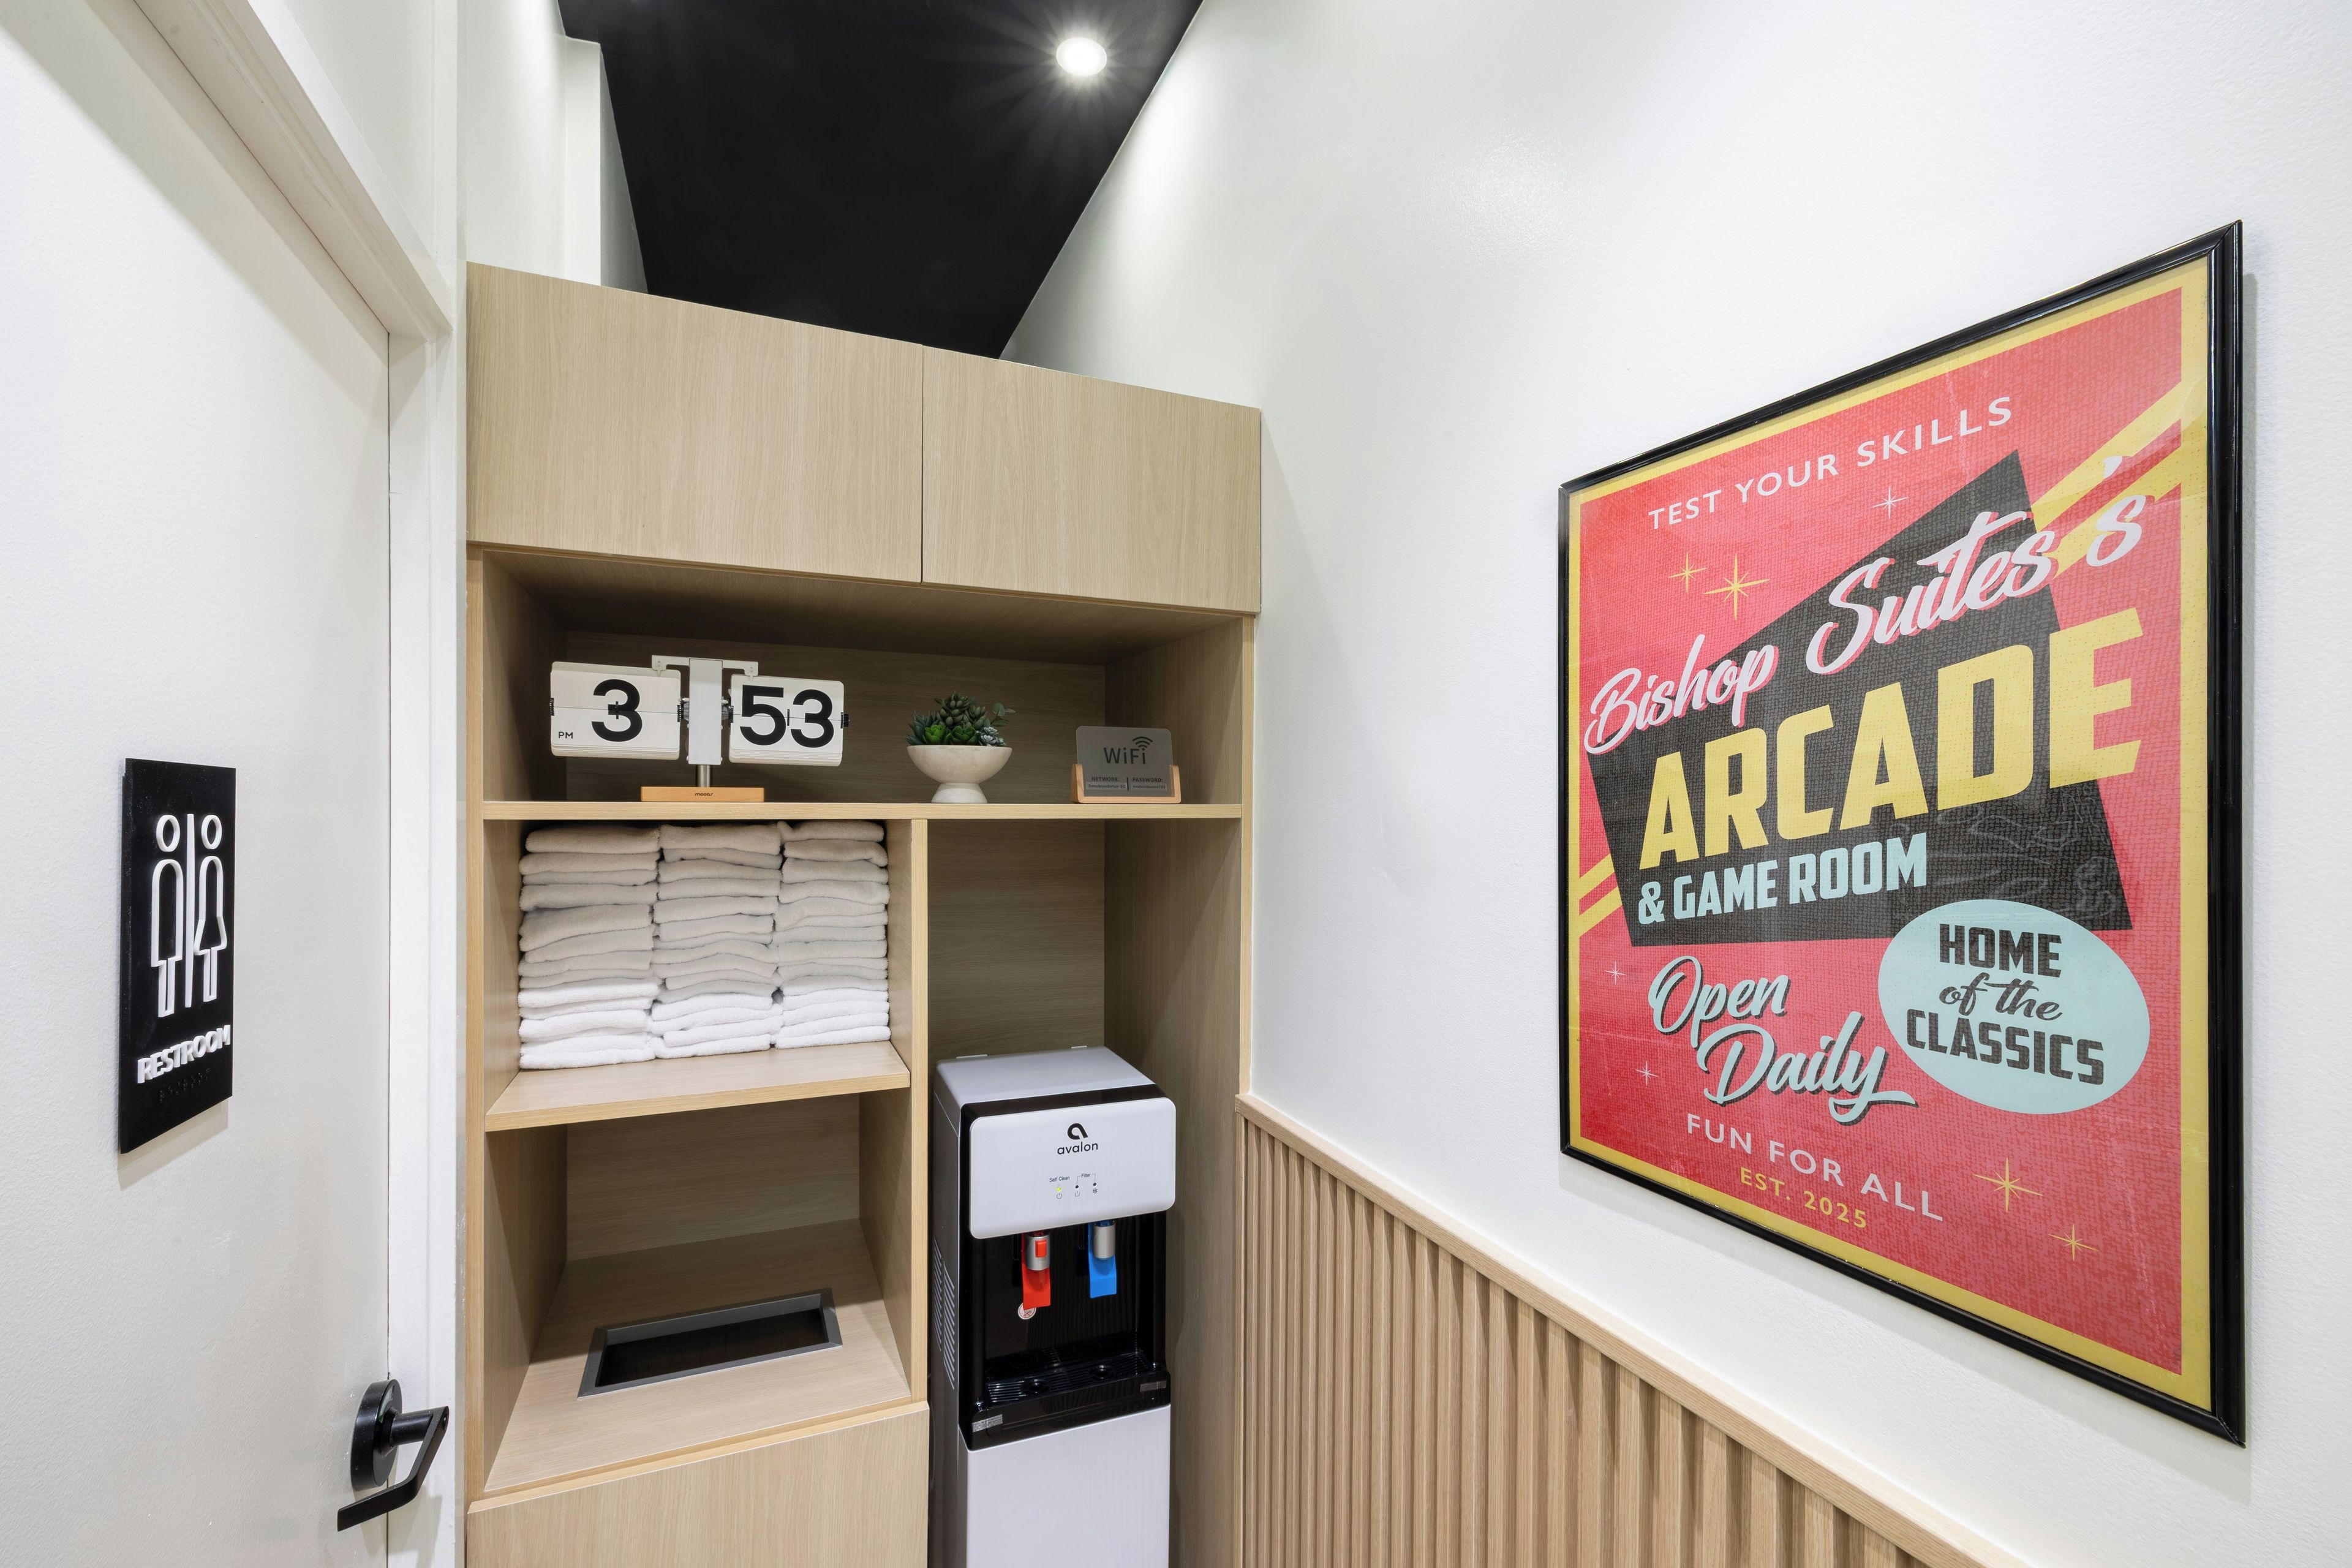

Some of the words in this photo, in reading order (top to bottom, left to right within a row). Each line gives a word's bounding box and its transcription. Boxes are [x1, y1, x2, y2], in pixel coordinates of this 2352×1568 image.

[1648, 490, 1722, 530] TEST
[1735, 454, 1839, 503] YOUR
[1857, 396, 2011, 467] SKILLS
[591, 679, 643, 742] 3
[739, 684, 834, 748] 53
[1584, 634, 1778, 755] Bishop
[1103, 747, 1147, 764] WiFi
[1639, 607, 2144, 870] ARCADE
[1638, 881, 1665, 925] &
[1673, 859, 1778, 919] GAME
[1789, 832, 1928, 904] ROOM
[1939, 923, 2062, 978] HOME
[1648, 956, 1791, 1049] Open
[1939, 972, 1990, 1016] of
[1984, 978, 2063, 1020] the
[137, 1024, 231, 1084] RESTROOM
[1696, 1011, 1919, 1126] Daily
[1907, 1009, 2105, 1085] CLASSICS
[1057, 1141, 1098, 1155] avalon
[1687, 1114, 1752, 1155] FUN
[1770, 1140, 1844, 1187] FOR
[1860, 1173, 1943, 1221] ALL
[1740, 1167, 1791, 1200] EST.
[1804, 1191, 1867, 1229] 2025
